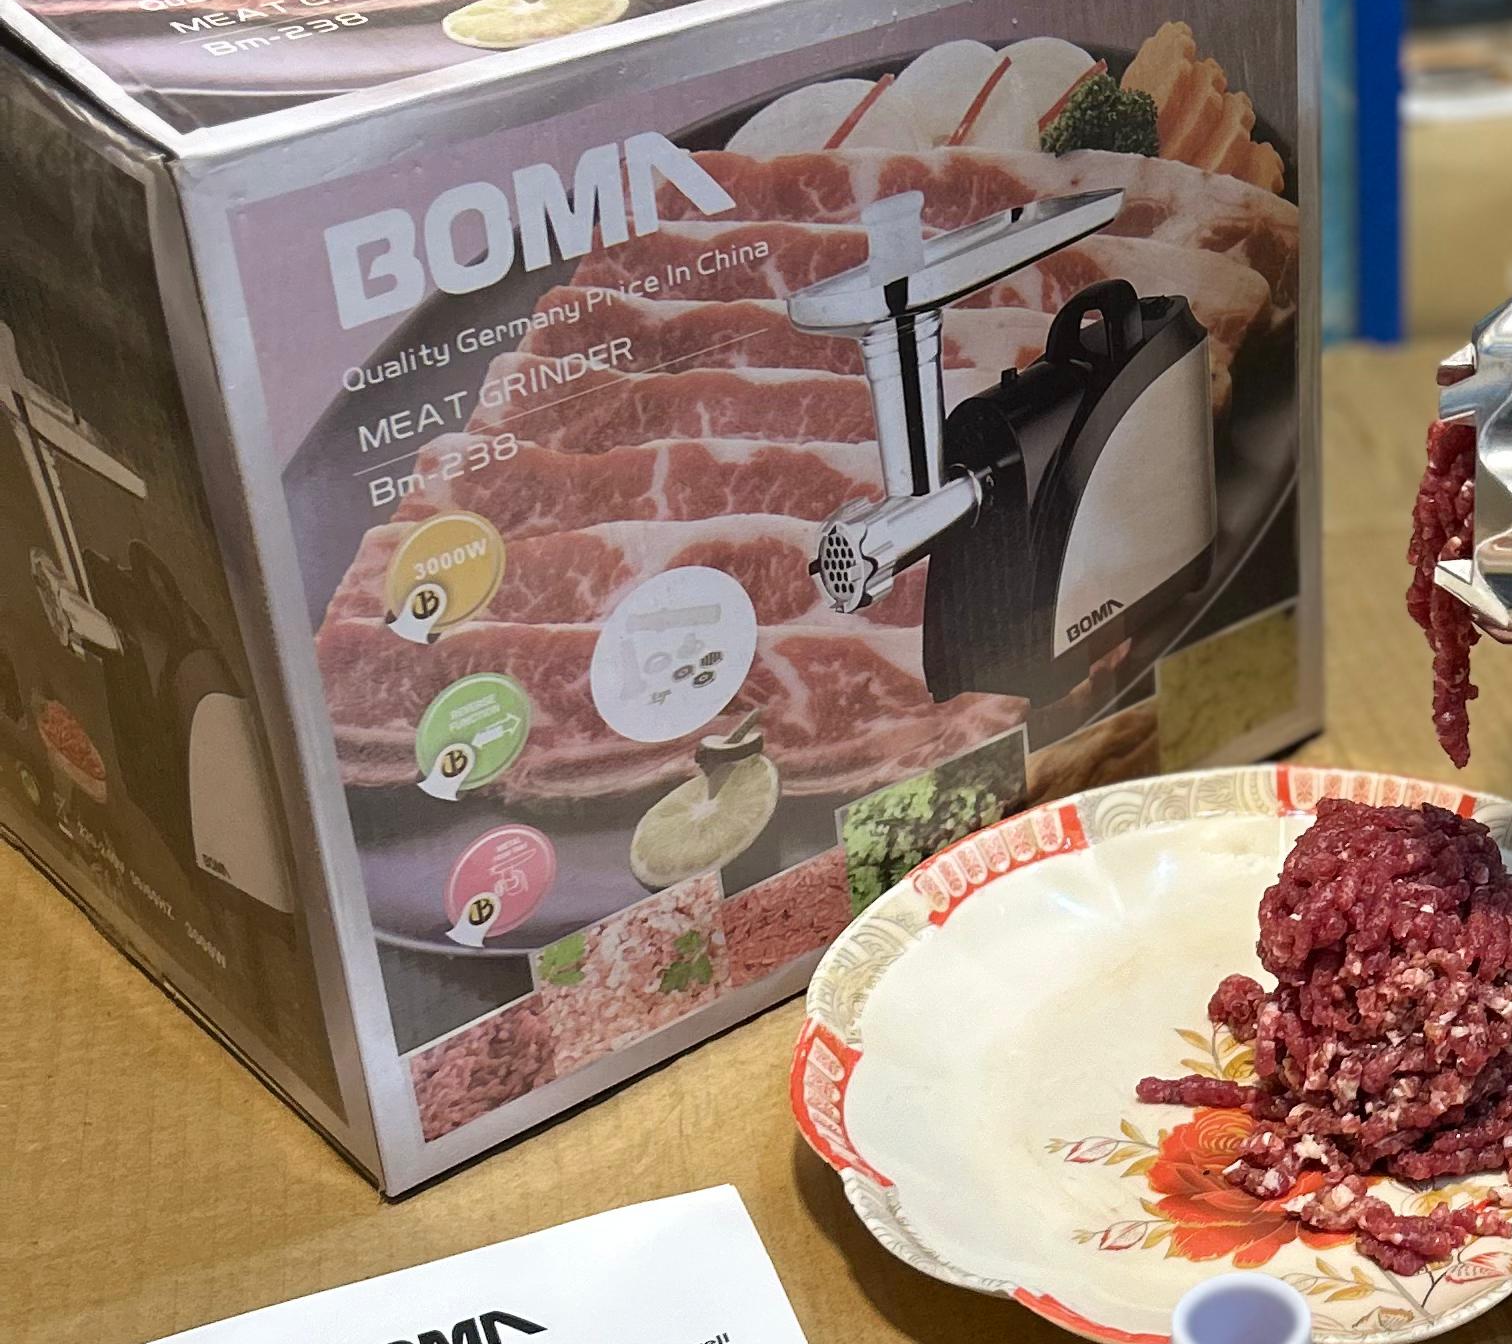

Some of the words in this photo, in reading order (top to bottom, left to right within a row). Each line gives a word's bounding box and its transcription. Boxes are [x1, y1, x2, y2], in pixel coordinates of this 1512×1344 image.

[202, 11, 369, 57] Bm-238
[324, 131, 737, 330] BOMA
[342, 340, 450, 392] Quality
[456, 298, 581, 354] Germany
[586, 275, 660, 314] Price
[667, 264, 691, 286] In
[696, 239, 770, 275] China
[358, 390, 468, 453] MEAT
[478, 337, 634, 407] GRINDER
[368, 433, 519, 507] Bm-238
[413, 537, 487, 581] 3000W
[1066, 599, 1124, 643] BOMA
